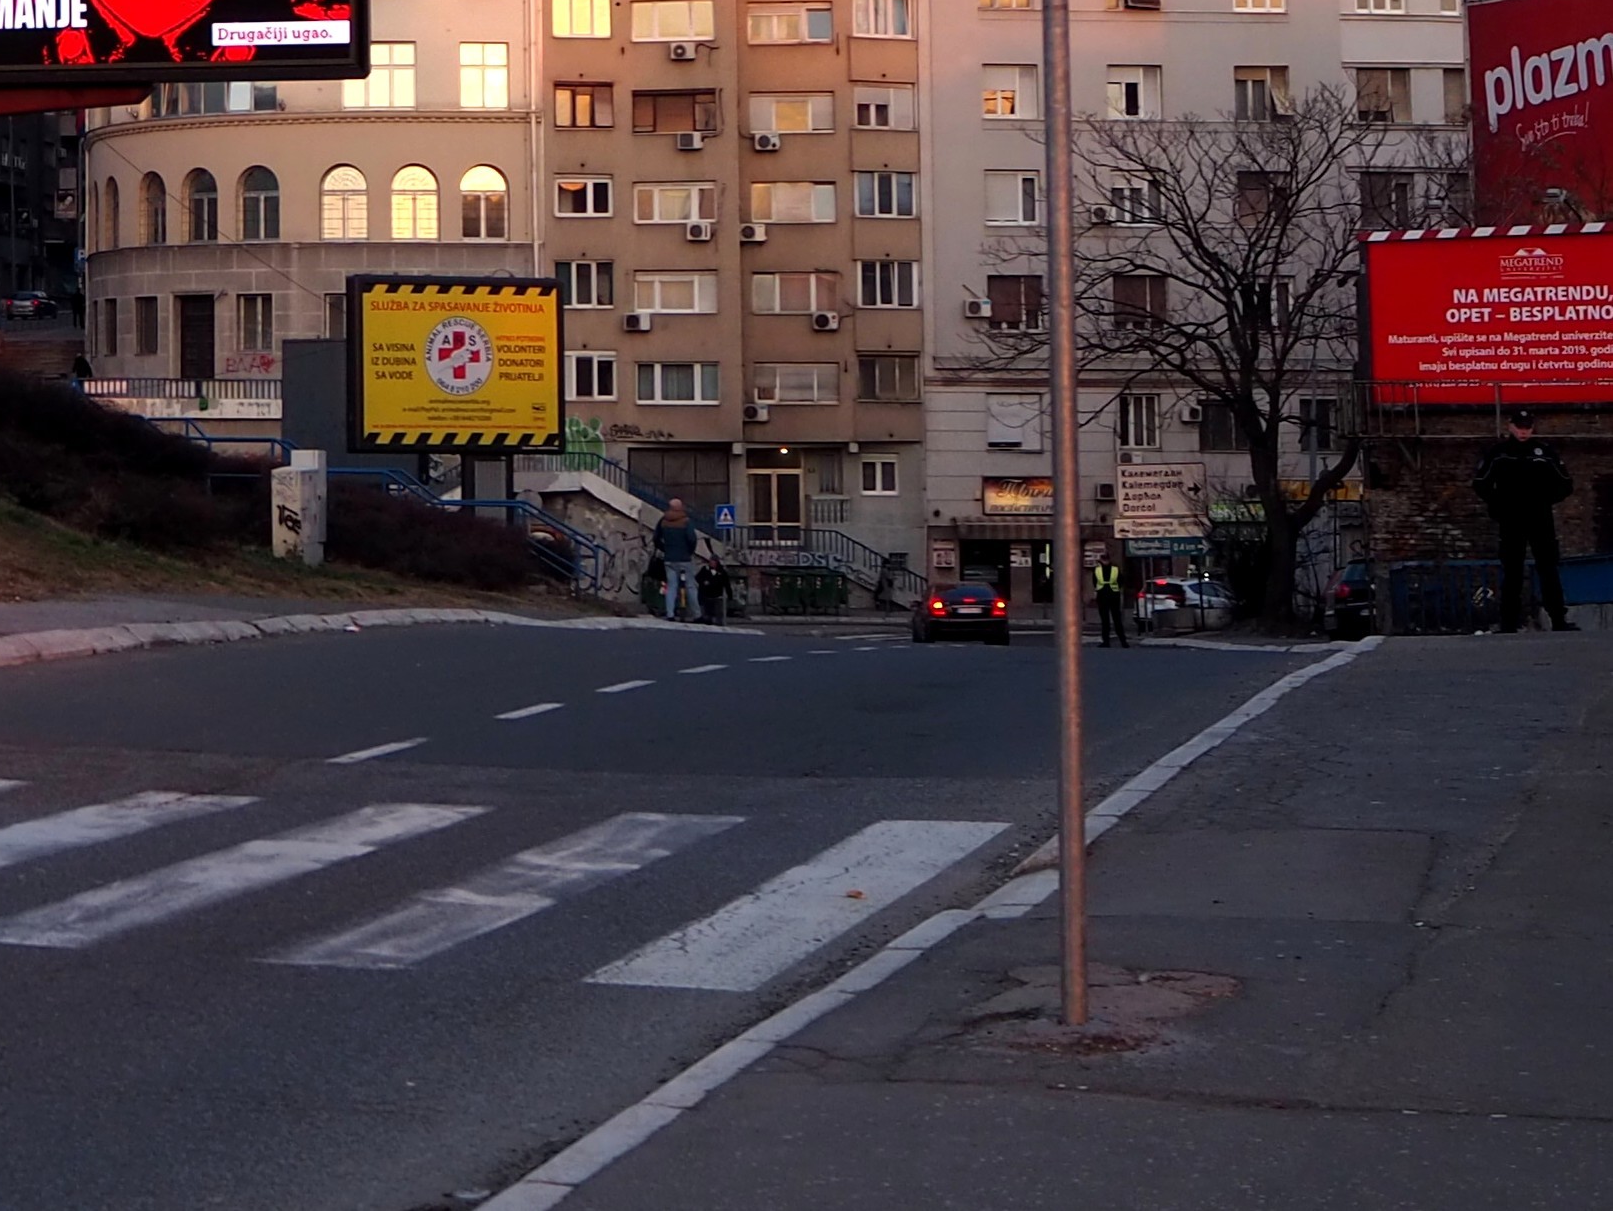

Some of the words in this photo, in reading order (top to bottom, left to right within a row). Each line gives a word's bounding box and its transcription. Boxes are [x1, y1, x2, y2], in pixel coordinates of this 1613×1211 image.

[217, 24, 285, 46] Drugačiji
[289, 27, 333, 44] ugao.
[1499, 256, 1564, 268] MEGATREND
[1453, 288, 1479, 303] NA
[1483, 284, 1613, 303] MEGATRENDU,
[370, 299, 410, 312] SLUŽBA
[412, 301, 426, 312] ZA
[428, 301, 491, 313] SPASAVANJE
[493, 300, 545, 314] ŽIVOTINJA
[1445, 307, 1492, 323] OPET
[1509, 304, 1613, 322] BESPLATNO
[1388, 333, 1440, 344] Maturanti,
[1440, 332, 1474, 345] upišite
[1475, 334, 1488, 343] se
[1488, 333, 1501, 342] na
[1503, 331, 1560, 344] Megatrend
[372, 343, 385, 353] SA
[386, 343, 416, 353] VISINA
[496, 345, 546, 354] VOLONTERI
[1441, 346, 1458, 357] Svi
[1458, 345, 1496, 359] upisani
[1497, 345, 1511, 356] do
[1512, 345, 1528, 356] 31.
[1528, 346, 1560, 355] marta
[1561, 345, 1590, 355] 2019.
[371, 356, 379, 366] IZ
[381, 357, 417, 367] DUBINA
[498, 358, 545, 368] DONATORI
[1418, 361, 1448, 373] imaju
[1448, 360, 1499, 373] besplatnu
[1500, 360, 1532, 372] drugu
[1537, 359, 1576, 370] četvrtu
[1576, 358, 1613, 372] godinu
[375, 371, 387, 380] SA
[388, 371, 414, 381] VODE
[498, 372, 545, 382] PRIJATELJI
[1121, 469, 1183, 478] Калемегдан
[1121, 480, 1185, 491] Kalemegdan
[1122, 492, 1162, 502] Дорћол
